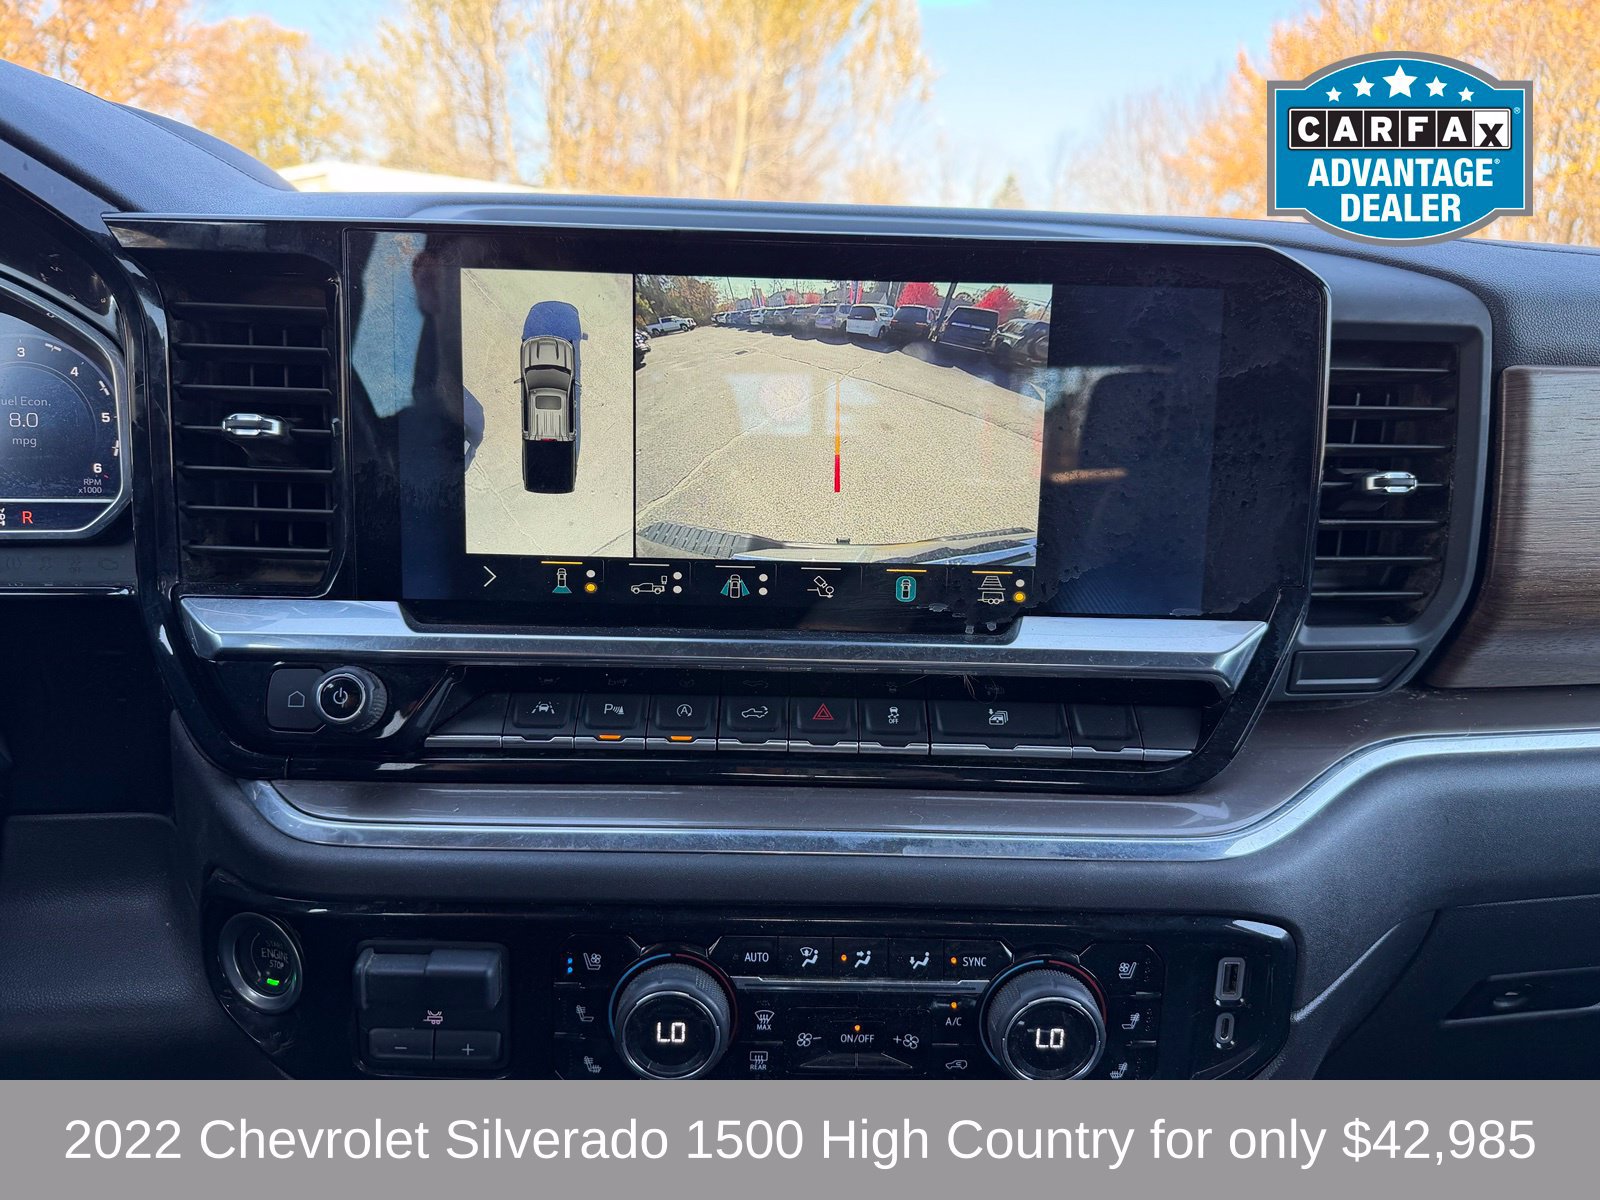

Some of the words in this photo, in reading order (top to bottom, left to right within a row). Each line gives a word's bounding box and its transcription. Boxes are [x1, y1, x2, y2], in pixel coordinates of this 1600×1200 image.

[16, 347, 25, 358] 3
[70, 366, 79, 377] 4
[0, 395, 17, 406] uel
[20, 395, 52, 407] Econ.
[9, 412, 39, 428] 8.0
[101, 412, 110, 423] 5
[12, 436, 37, 448] mpg
[92, 463, 103, 474] 6
[83, 478, 102, 486] RPM
[78, 486, 103, 494] x1000
[22, 510, 34, 524] R
[260, 947, 289, 963] ENGINE
[744, 951, 770, 963] AUTO
[269, 959, 285, 969] STOP
[962, 956, 987, 968] SYNC
[756, 1023, 772, 1031] MAX
[945, 1017, 962, 1027] A/C
[656, 1021, 686, 1043] LO
[840, 1033, 875, 1044] ON/OFF
[1035, 1027, 1065, 1049] LO
